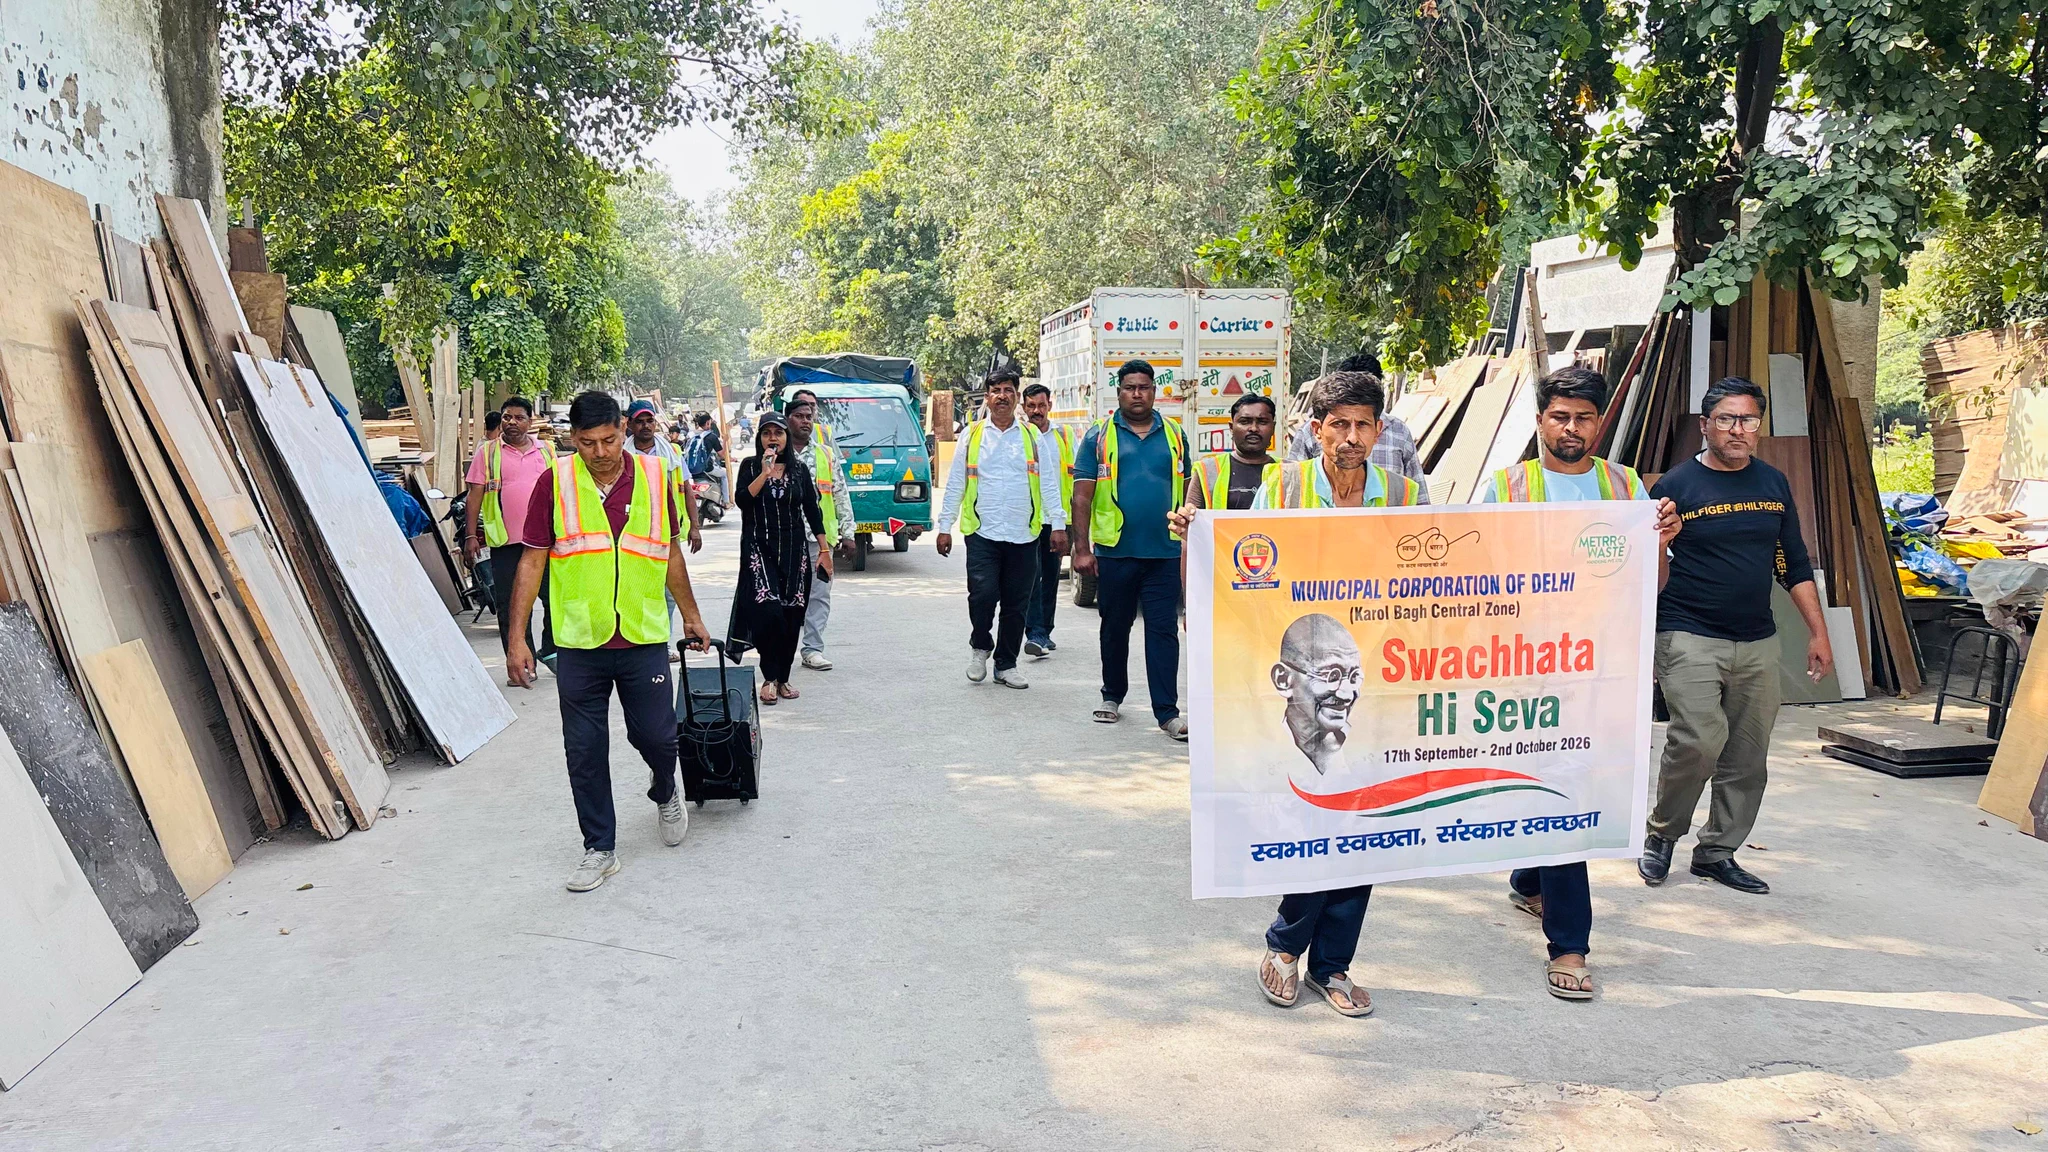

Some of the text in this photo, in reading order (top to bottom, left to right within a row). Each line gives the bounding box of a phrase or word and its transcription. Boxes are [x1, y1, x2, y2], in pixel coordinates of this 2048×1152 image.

[1116, 316, 1159, 333] Public
[1201, 368, 1221, 387] बेटी
[1199, 430, 1236, 452] HOR
[1681, 501, 1784, 521] HILFIGER HILFIGER
[1588, 546, 1625, 558] WASTE
[1291, 571, 1575, 602] MUNICIPAL CORPORATION OF DELHI
[1350, 600, 1520, 624] (Karol Bagh Central Zone)
[1382, 632, 1594, 683] Swachhata
[1417, 690, 1560, 736] Hi Seva
[1384, 749, 1410, 763] 17th
[1414, 746, 1478, 763] September
[1490, 742, 1512, 757] 2nd
[1516, 739, 1557, 755] October
[1561, 736, 1591, 751] 2026
[1251, 811, 1601, 861] स्वभाव स्वच्छता, संस्कार स्वच्छता
